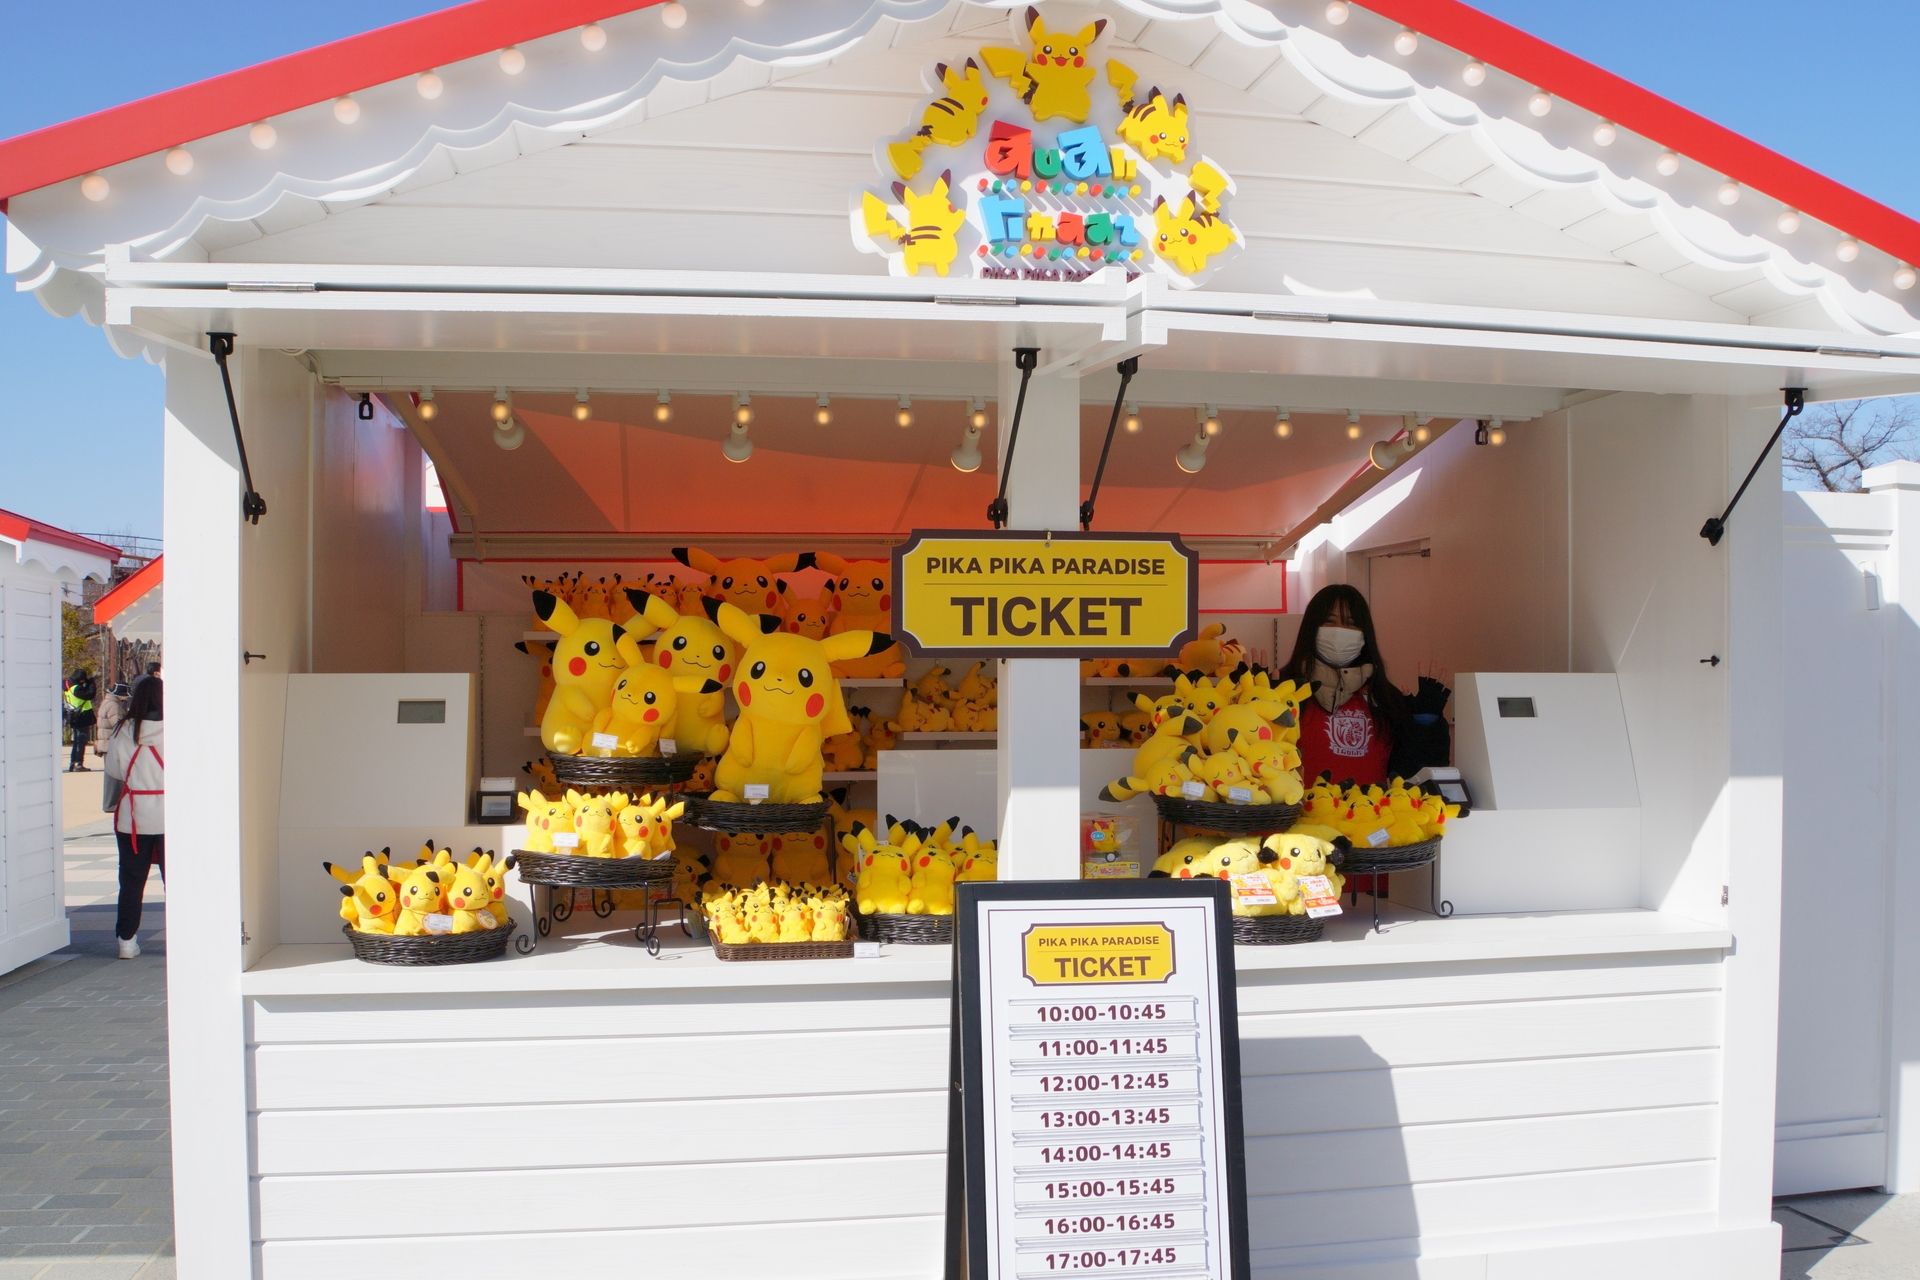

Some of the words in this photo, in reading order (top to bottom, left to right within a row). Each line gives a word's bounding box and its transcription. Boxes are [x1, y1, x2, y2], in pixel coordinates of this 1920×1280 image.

[981, 267, 1019, 280] PIKA
[1023, 268, 1060, 281] PIKA
[927, 557, 983, 574] PIKA
[989, 557, 1045, 574] PIKA
[1052, 558, 1165, 575] PARADISE
[950, 596, 1143, 636] TICKET
[1039, 938, 1066, 947] PIKA
[1070, 937, 1098, 946] PIKA
[1102, 936, 1160, 946] PARADISE
[1054, 956, 1151, 978] TICKET
[1037, 1004, 1166, 1021] 10:00-10:45
[1038, 1039, 1168, 1056] 11:00-11:45
[1040, 1073, 1169, 1091] 12:00-12:45
[1040, 1108, 1170, 1127] 13:00-13:45
[1041, 1143, 1171, 1163] 14:00-14:45
[1045, 1179, 1175, 1198] 15:00-15:45
[1044, 1214, 1175, 1234] 16:00-16:45
[1045, 1248, 1176, 1269] 17:00-17:45
